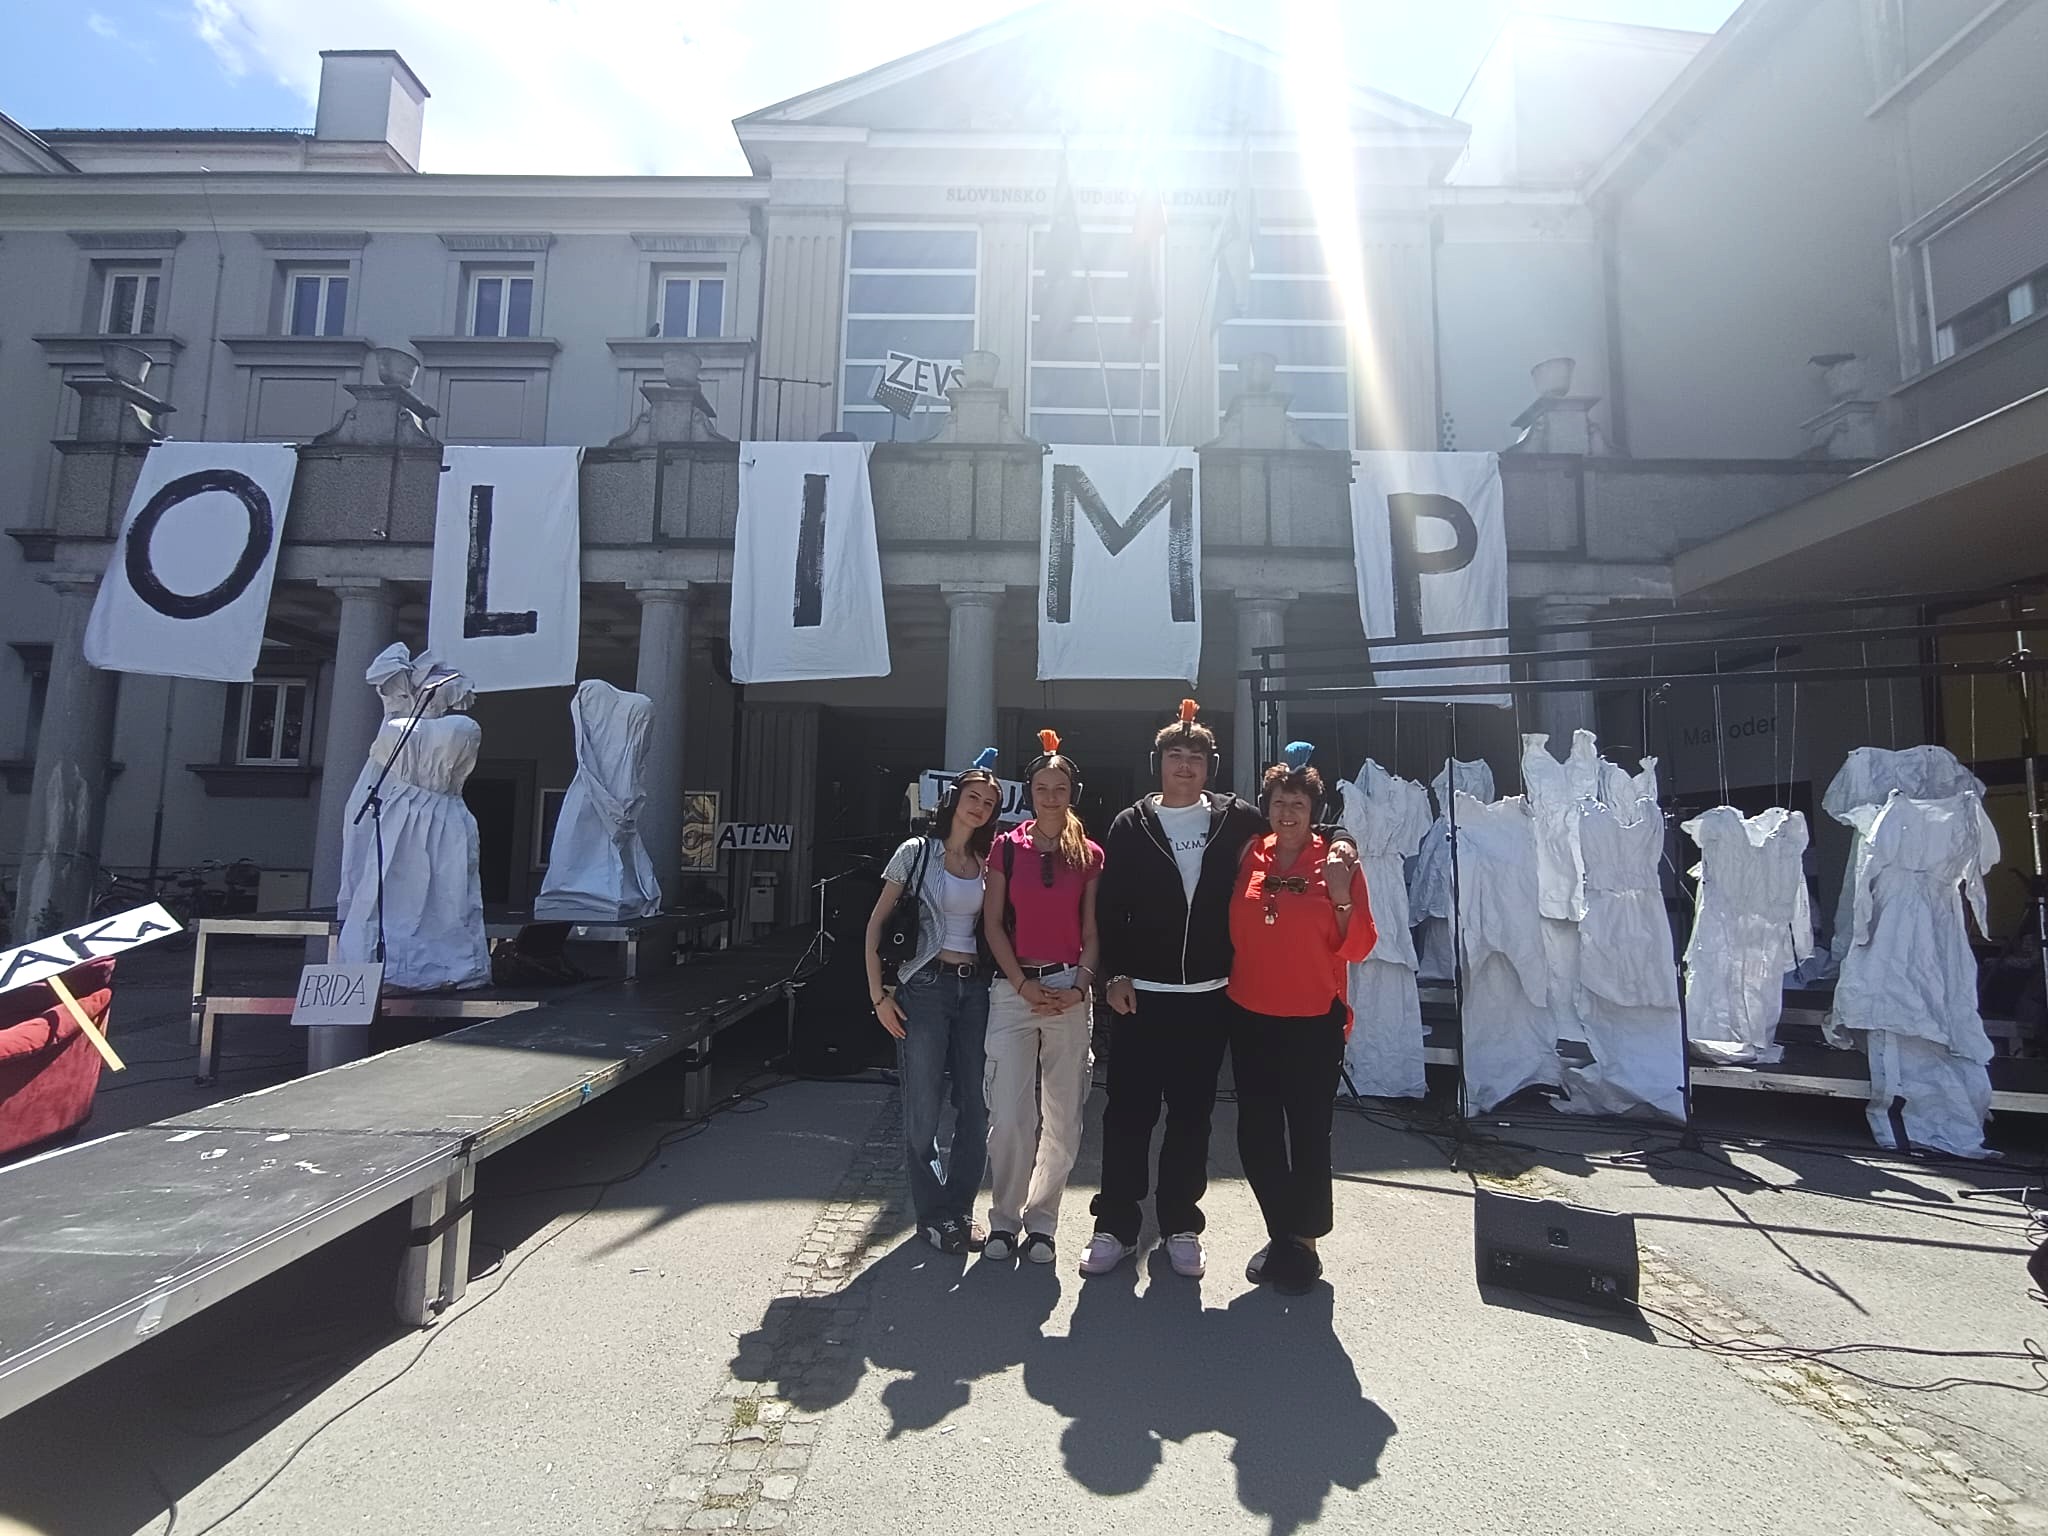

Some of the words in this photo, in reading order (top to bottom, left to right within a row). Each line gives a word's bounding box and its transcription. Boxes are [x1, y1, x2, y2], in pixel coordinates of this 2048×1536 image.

[945, 187, 1047, 203] SLOVENSKO
[1729, 716, 1776, 740] oder
[717, 823, 789, 848] ATENA
[0, 920, 171, 988] AKA
[300, 973, 367, 1008] ERIDA
